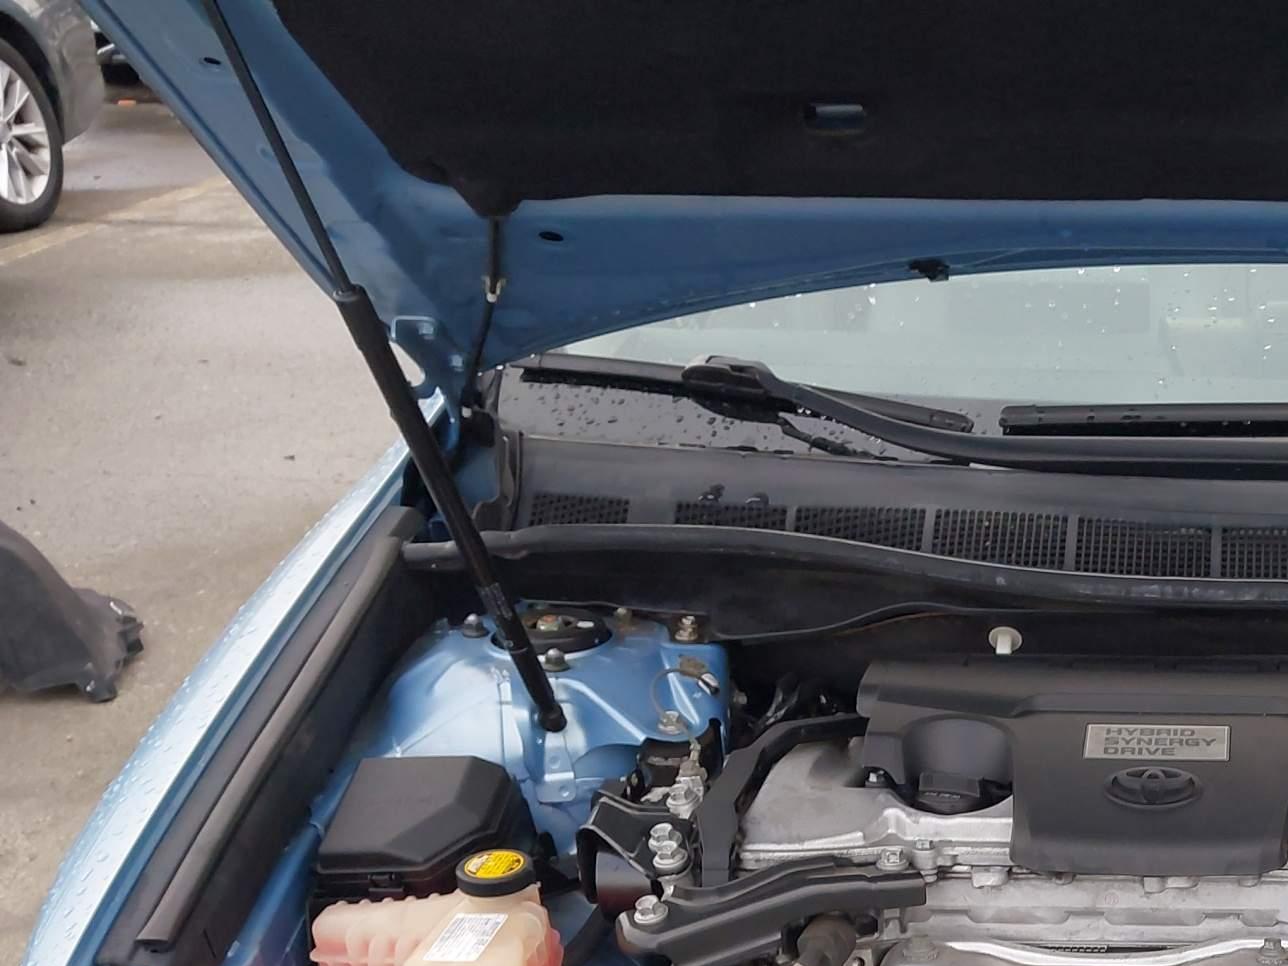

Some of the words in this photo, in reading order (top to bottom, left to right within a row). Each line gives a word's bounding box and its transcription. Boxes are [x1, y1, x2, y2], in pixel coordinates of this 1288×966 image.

[1105, 727, 1196, 737] HYBRID
[1104, 736, 1217, 747] SYNERGY
[1103, 746, 1176, 756] DRIVE
